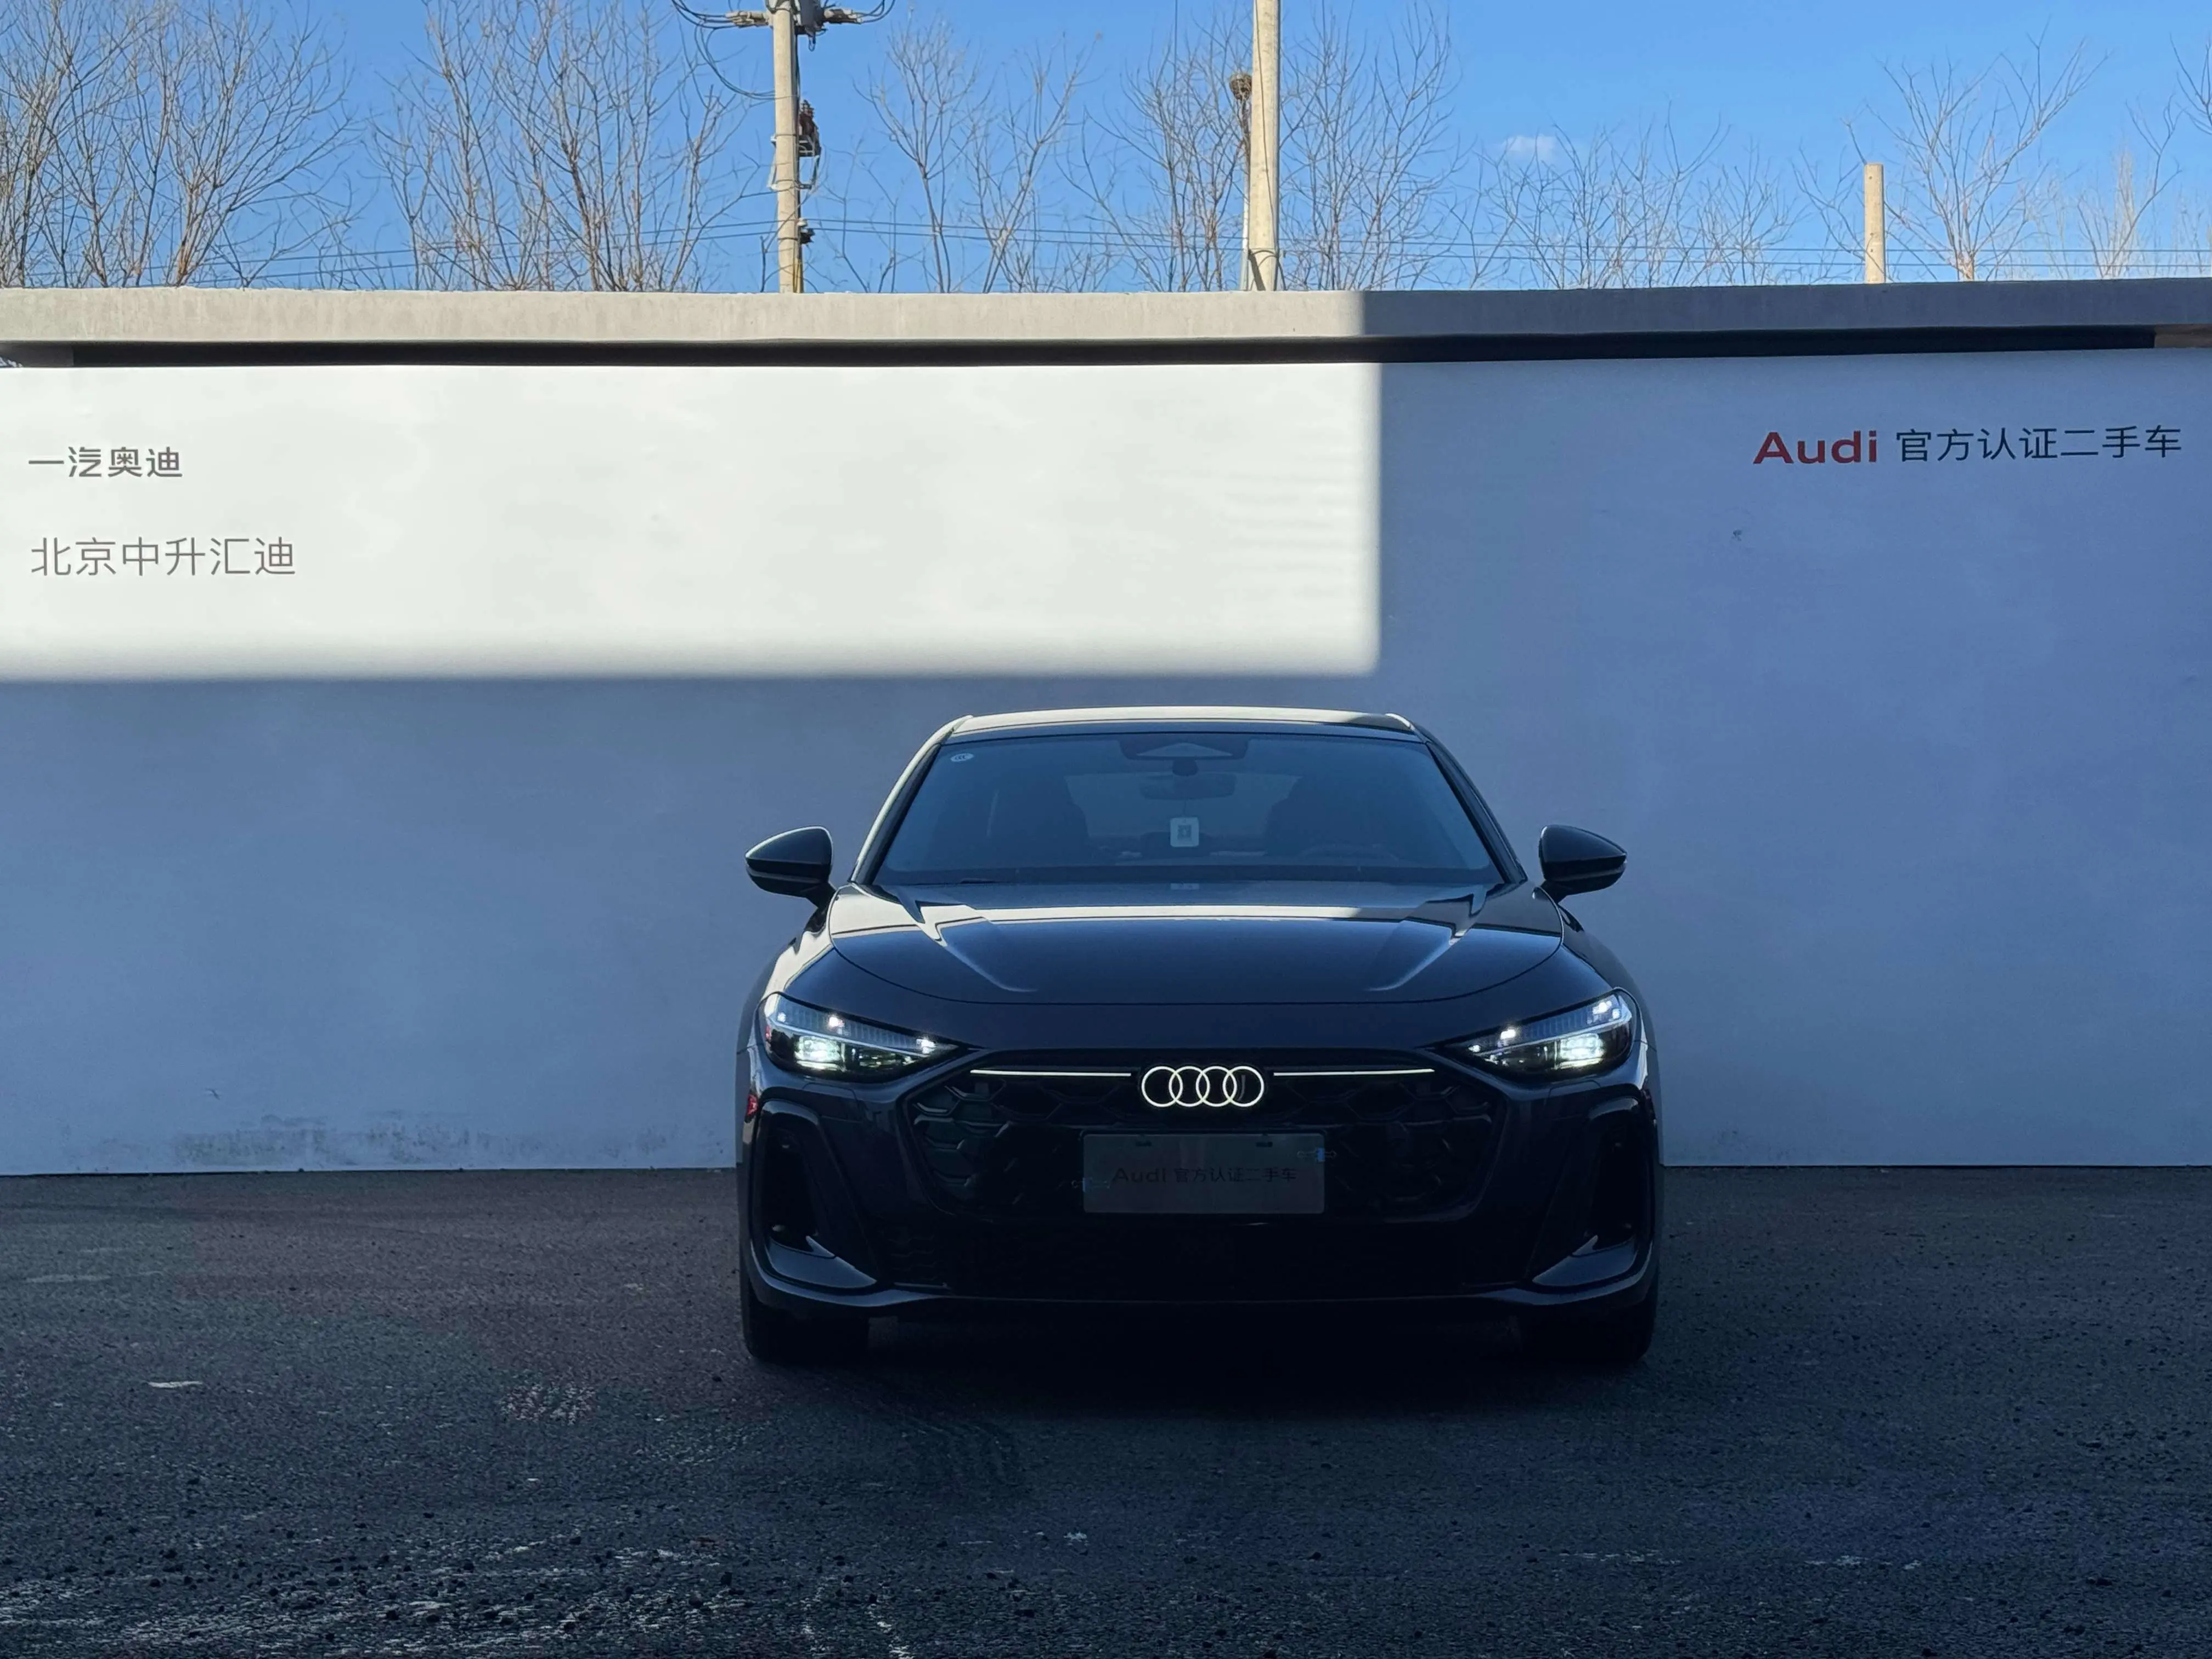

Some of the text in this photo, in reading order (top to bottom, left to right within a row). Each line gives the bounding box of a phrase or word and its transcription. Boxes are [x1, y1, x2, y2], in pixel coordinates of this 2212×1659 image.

[1753, 425, 2182, 464] Audi 官方认证二手车
[29, 447, 183, 477] 一汽奥迪
[31, 537, 295, 576] 北京中升汇迪
[1112, 1166, 1297, 1183] Audi 官方认证二手车
